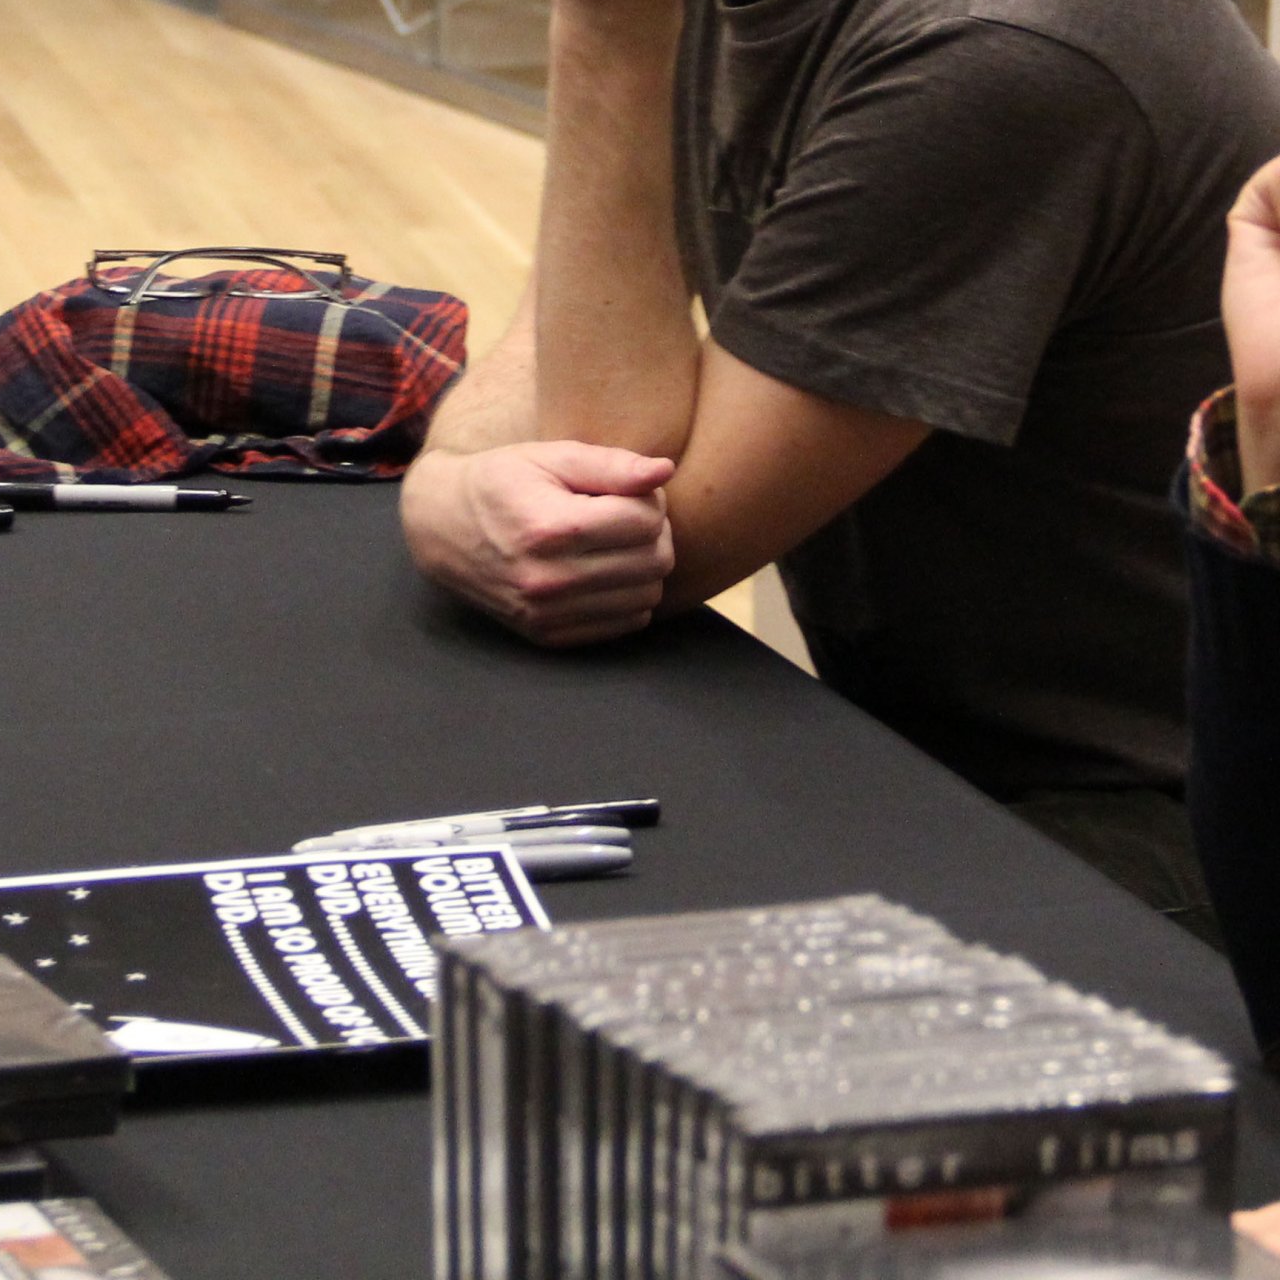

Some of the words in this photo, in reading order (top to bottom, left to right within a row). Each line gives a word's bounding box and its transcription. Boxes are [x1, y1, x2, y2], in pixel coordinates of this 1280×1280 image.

[245, 871, 287, 884] I
[412, 855, 487, 939] VOLUM
[452, 856, 523, 931] BITTER
[250, 886, 304, 927] AM
[267, 926, 318, 954] SO
[282, 953, 355, 1007] PROUD
[321, 1005, 374, 1028] OF
